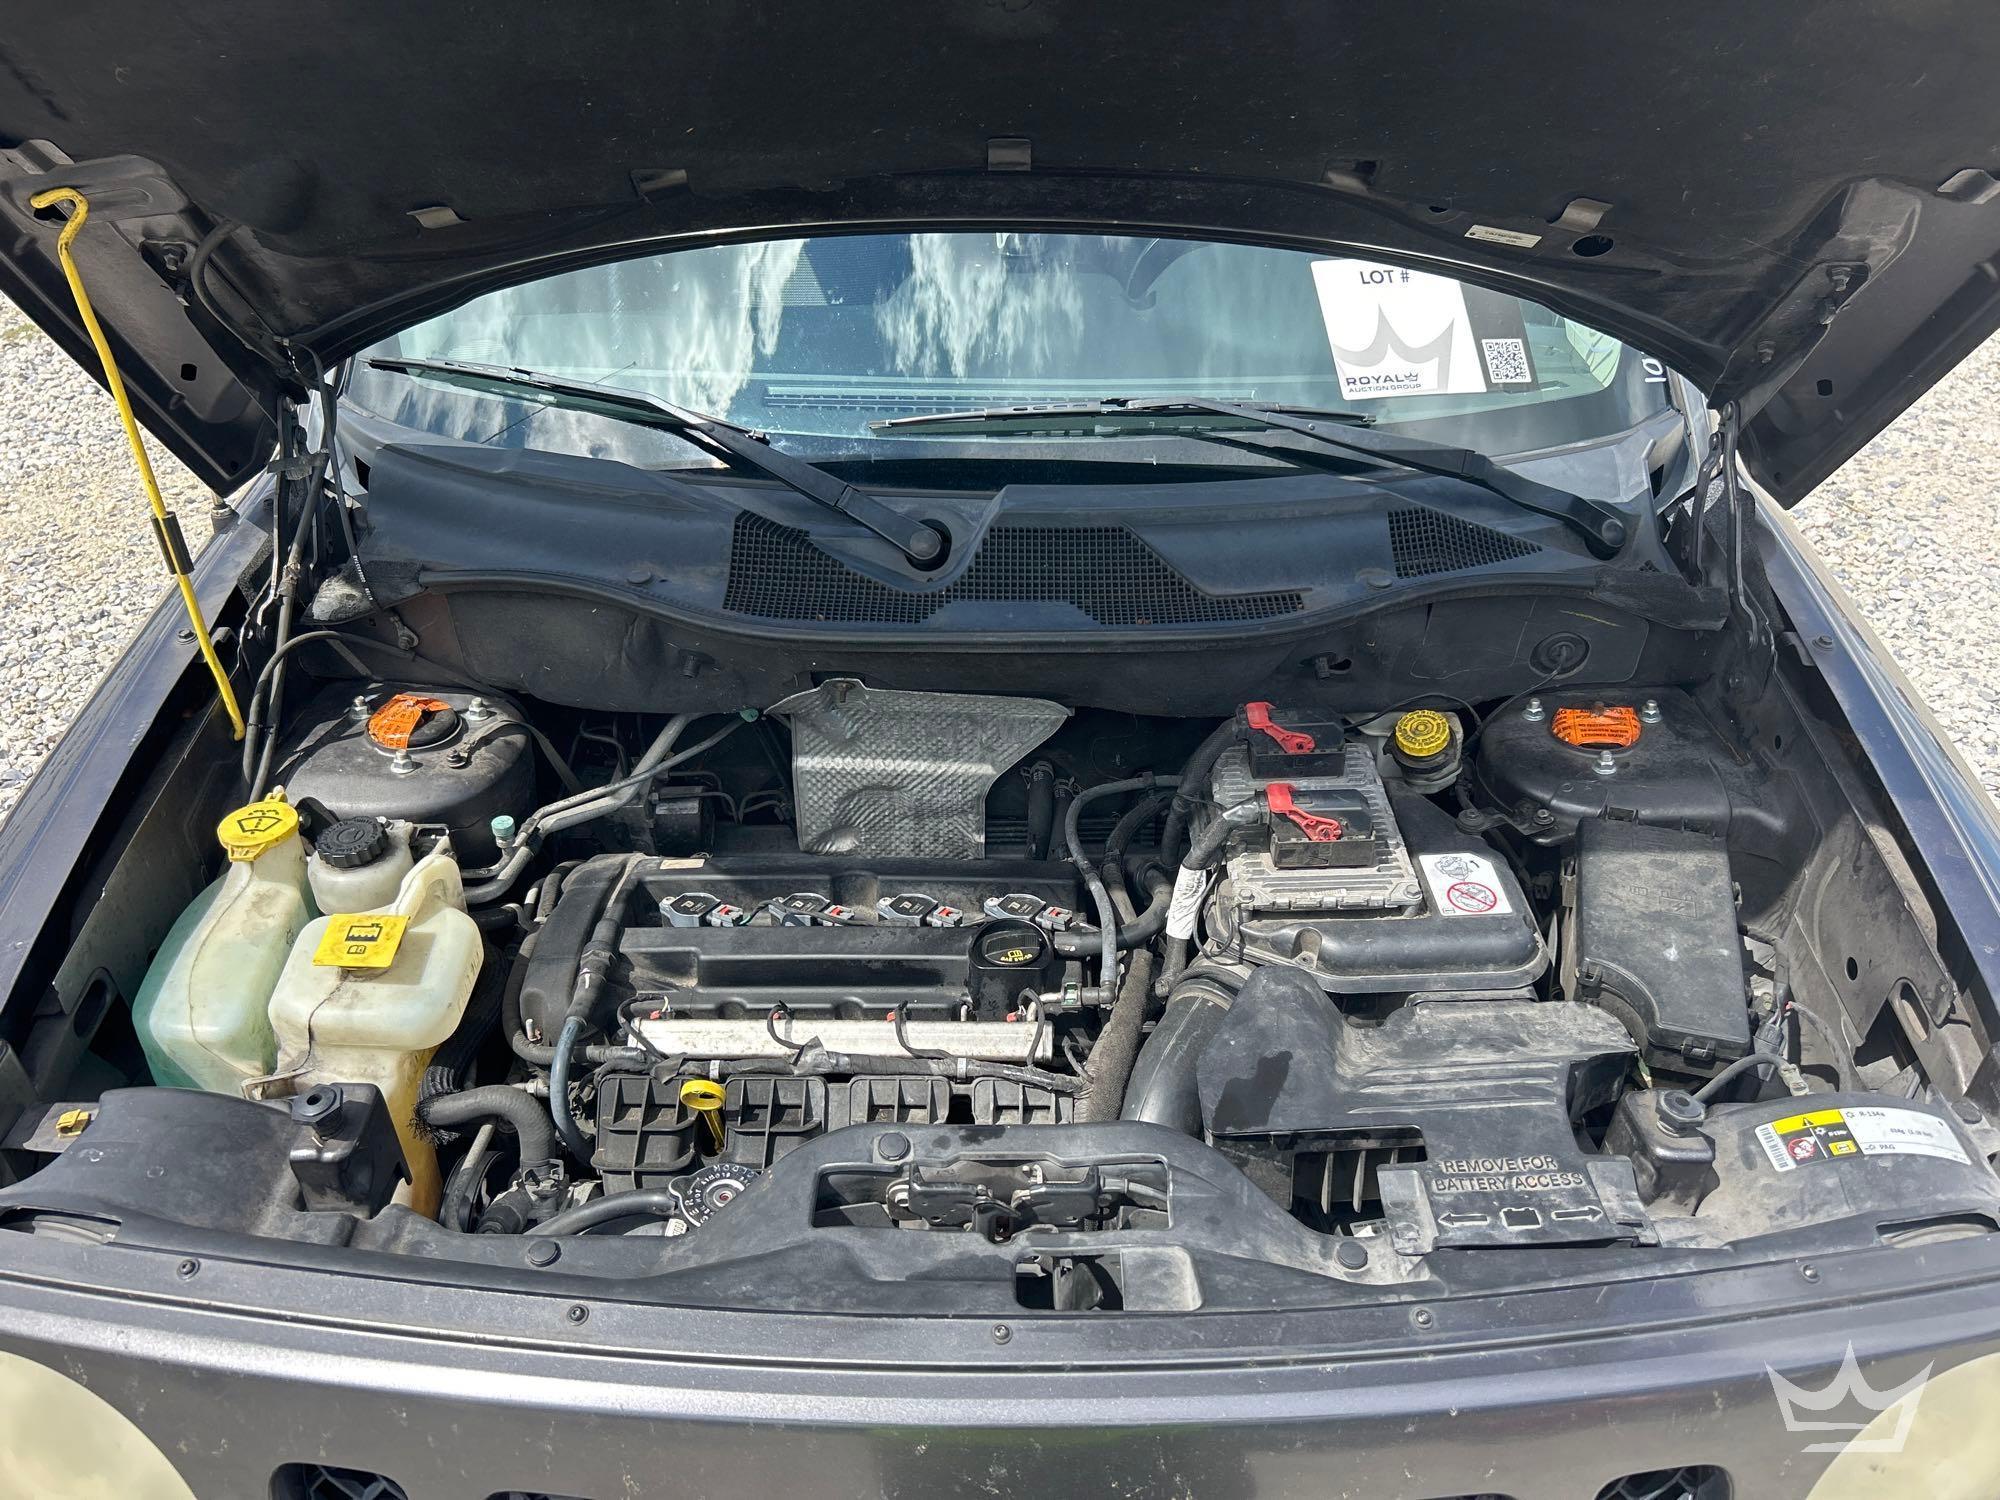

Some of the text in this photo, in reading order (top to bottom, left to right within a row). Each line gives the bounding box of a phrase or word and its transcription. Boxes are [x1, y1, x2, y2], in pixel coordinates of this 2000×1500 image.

[1360, 268, 1411, 284] LOT #
[1345, 374, 1405, 386] ROYAL
[1349, 383, 1422, 393] AUCTION GROUP
[1442, 1155, 1558, 1174] REMOVE FOR
[1434, 1173, 1584, 1192] BATTERY ACCESS
